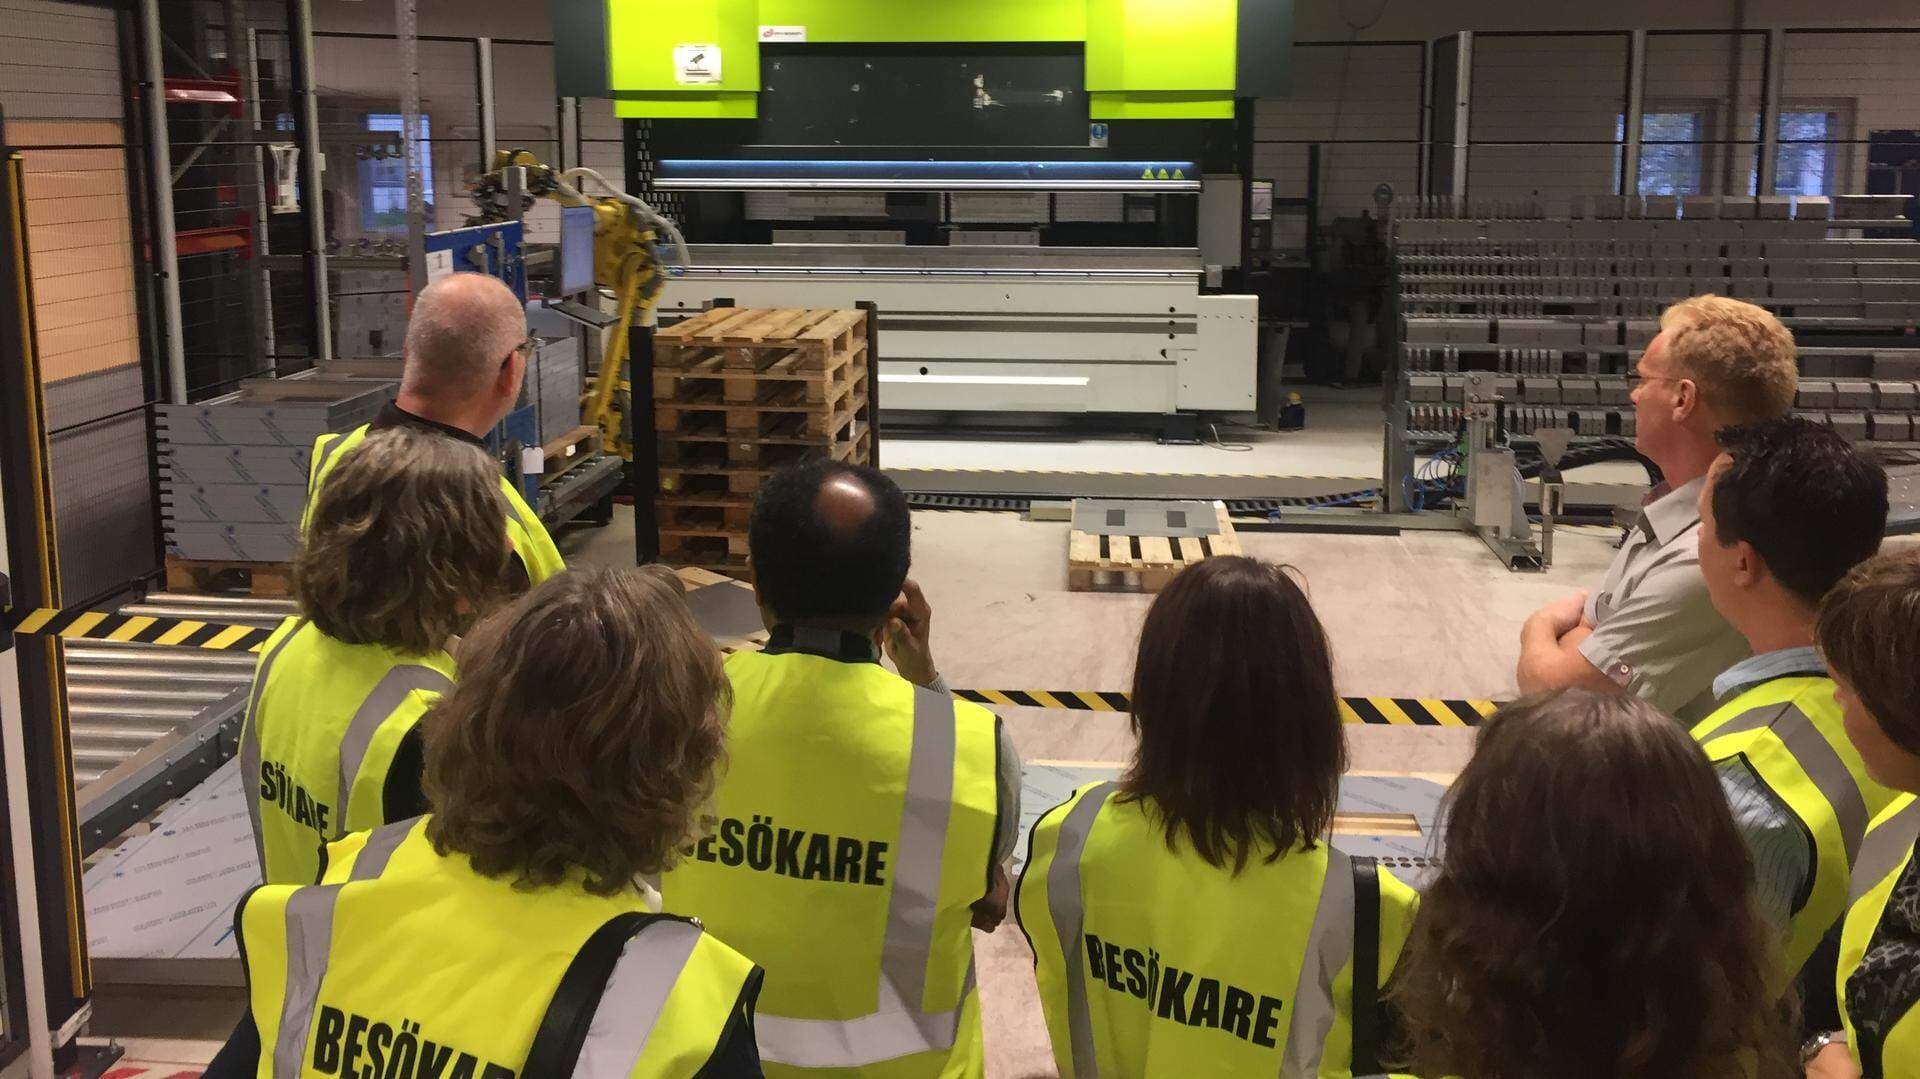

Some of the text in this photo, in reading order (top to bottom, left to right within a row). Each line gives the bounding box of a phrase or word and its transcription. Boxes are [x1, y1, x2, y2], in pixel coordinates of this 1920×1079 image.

[688, 815, 888, 886] ESÖKARE
[1085, 934, 1283, 1049] BESÖKARE
[312, 1004, 516, 1079] BESÖK
